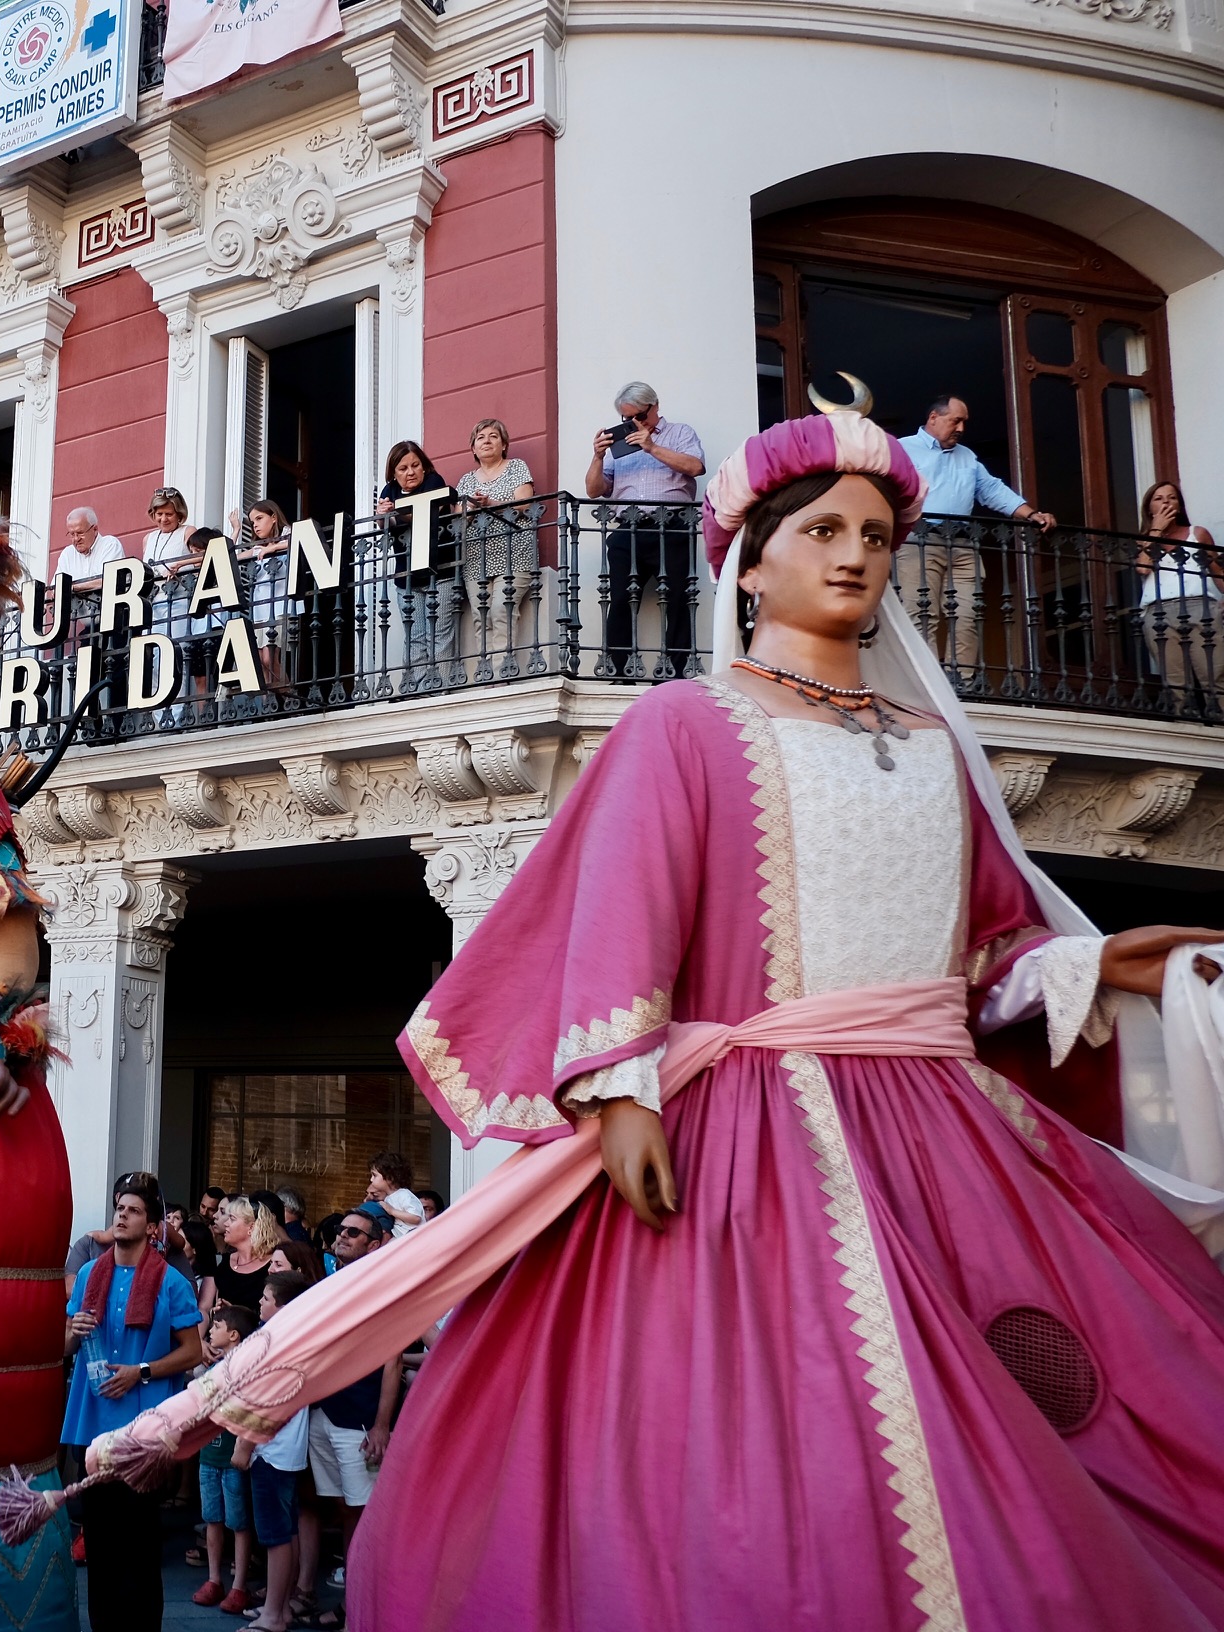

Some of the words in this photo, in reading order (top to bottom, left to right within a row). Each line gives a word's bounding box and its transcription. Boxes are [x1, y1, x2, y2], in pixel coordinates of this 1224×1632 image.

[2, 10, 37, 57] CENTRE
[213, 22, 233, 34] ELS
[4, 67, 27, 87] BAIX
[29, 48, 58, 84] CAMP
[50, 58, 113, 105] CONDUIR
[55, 88, 105, 129] ARMES
